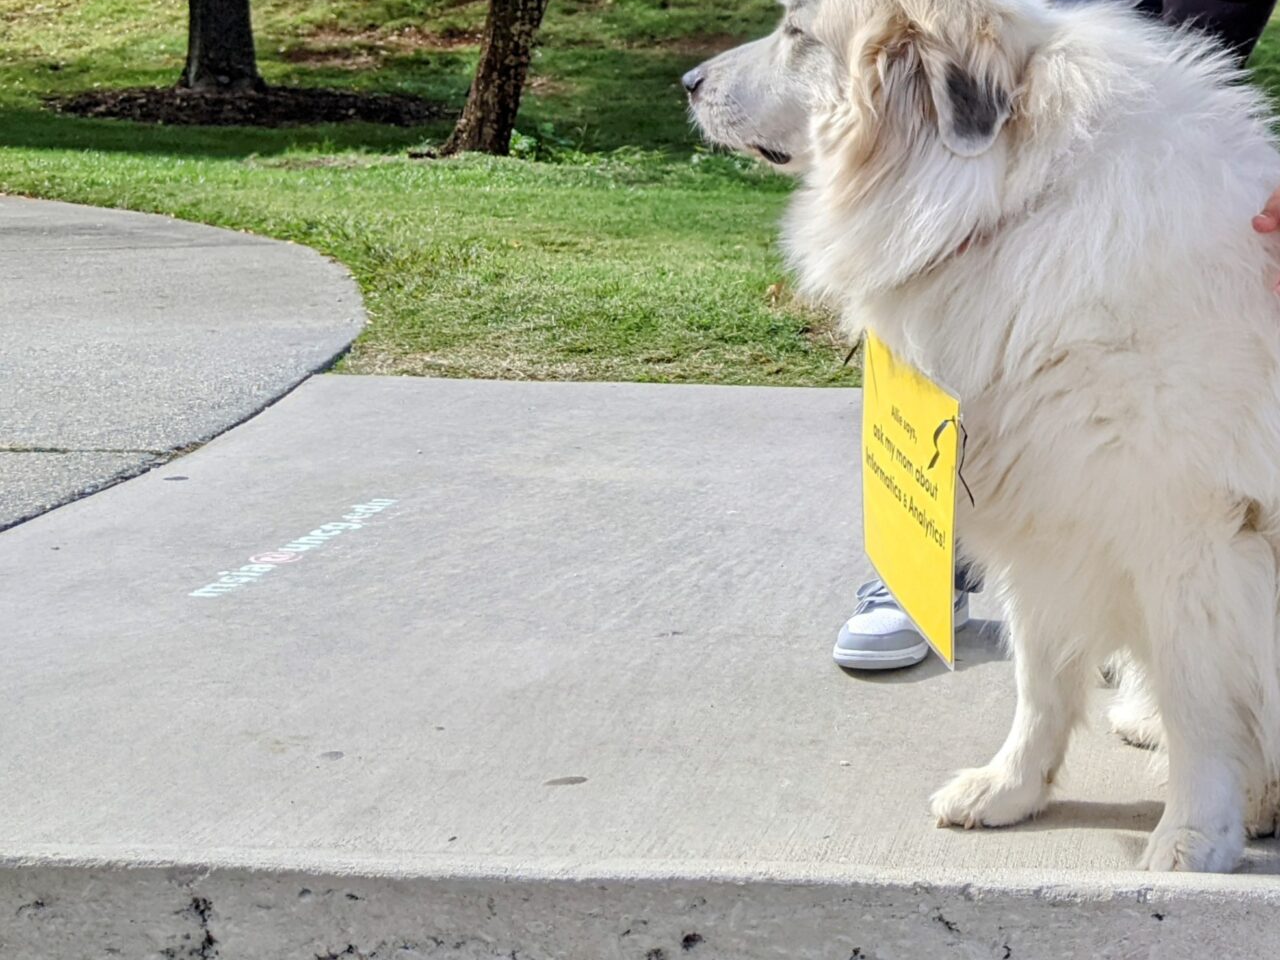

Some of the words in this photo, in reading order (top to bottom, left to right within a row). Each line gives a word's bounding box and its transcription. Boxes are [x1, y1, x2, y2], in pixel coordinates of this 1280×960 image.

[866, 447, 902, 502] Informatics
[908, 495, 946, 550] Analytics!
[873, 424, 884, 445] ask
[885, 437, 896, 462] my
[896, 448, 914, 477] mom
[914, 465, 939, 501] about
[188, 497, 400, 598] msia@uncg.edu
